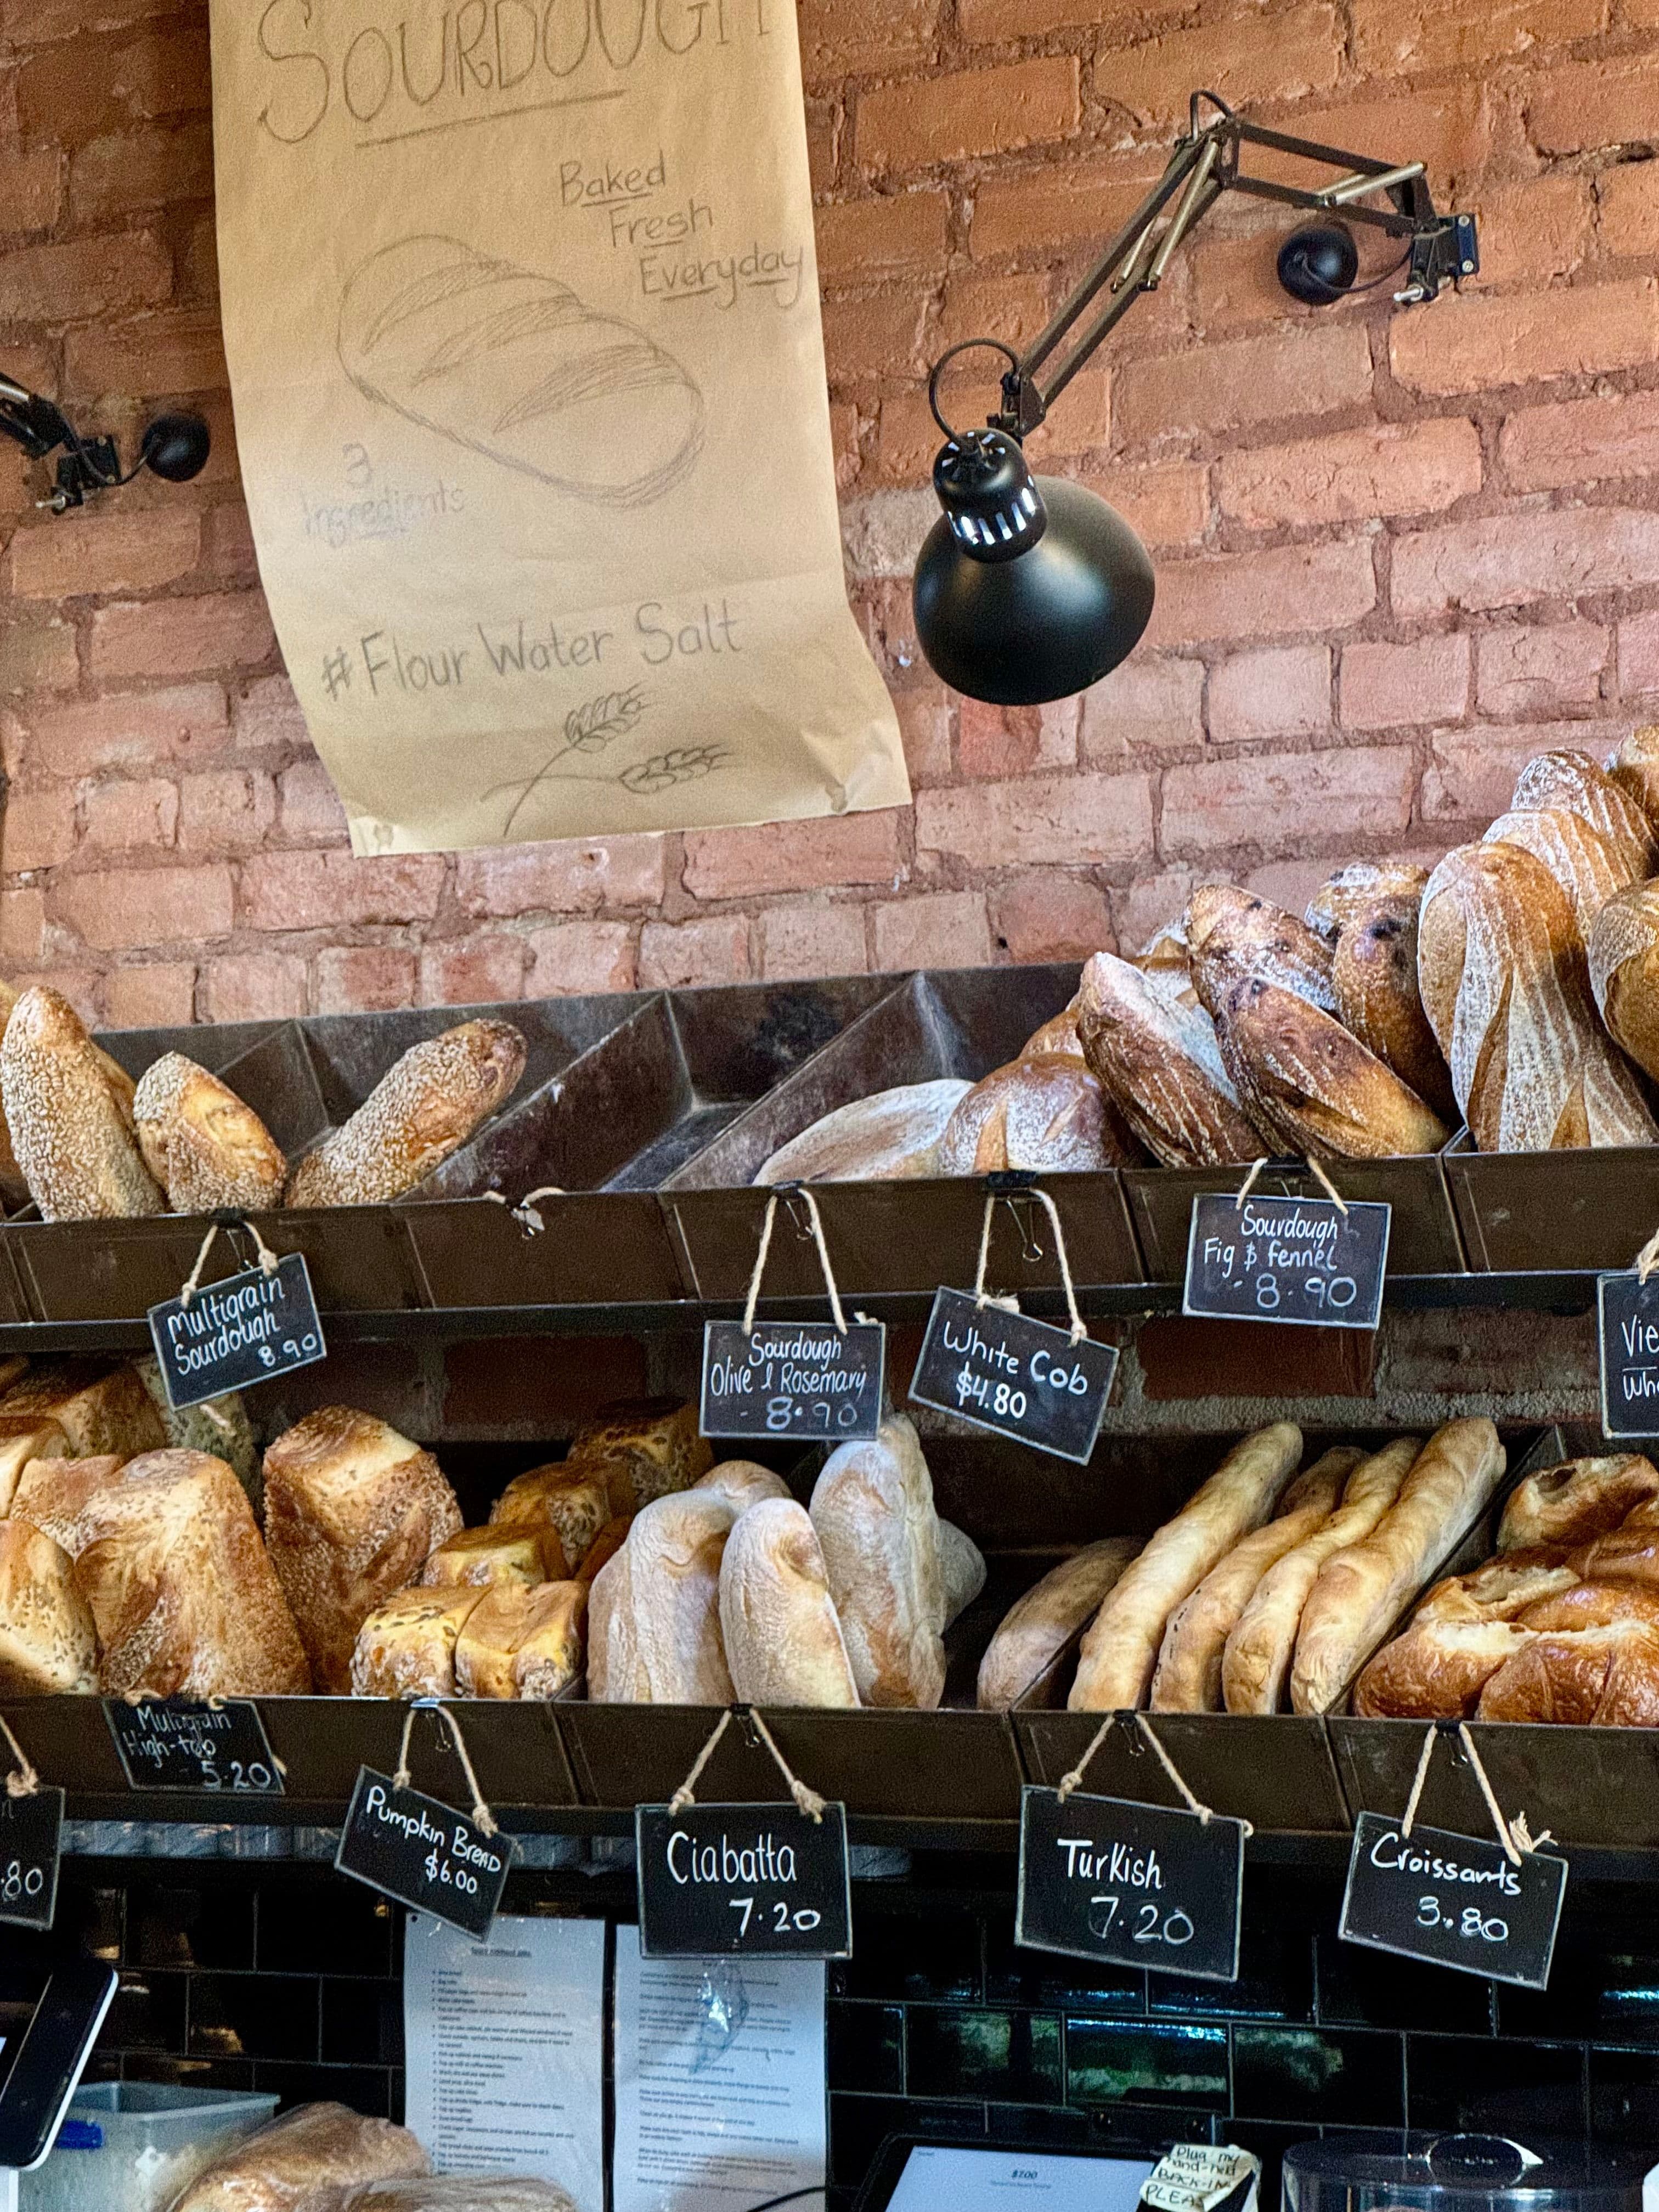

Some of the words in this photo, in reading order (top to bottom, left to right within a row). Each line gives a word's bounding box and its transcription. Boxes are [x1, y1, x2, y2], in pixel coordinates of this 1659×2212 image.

[559, 150, 665, 206] Baked
[609, 199, 713, 247] Fresh
[640, 245, 804, 309] Everyday
[342, 442, 374, 490] 3
[477, 618, 619, 675] Water
[635, 599, 744, 667] Salt
[1241, 1204, 1338, 1248] Sourdough
[1204, 1237, 1235, 1279] Fig
[167, 1276, 286, 1344] Multigrain
[174, 1308, 281, 1376] Sourdough
[748, 1330, 842, 1372] Sourdough
[943, 1321, 1019, 1374] White
[1029, 1350, 1088, 1395] Cob
[710, 1355, 753, 1396] Olive
[780, 1362, 867, 1400] Rosemary
[956, 1361, 1027, 1418] $4.80
[200, 1760, 271, 1791] 5.20
[366, 1785, 445, 1847] Pumpkin
[425, 1848, 478, 1894] $6.00
[667, 1831, 797, 1884] Ciabatta
[1370, 1832, 1522, 1895] Croissants
[729, 1898, 821, 1937] 7.20
[1090, 1896, 1194, 1945] 7.20
[1417, 1896, 1509, 1942] 3.80
